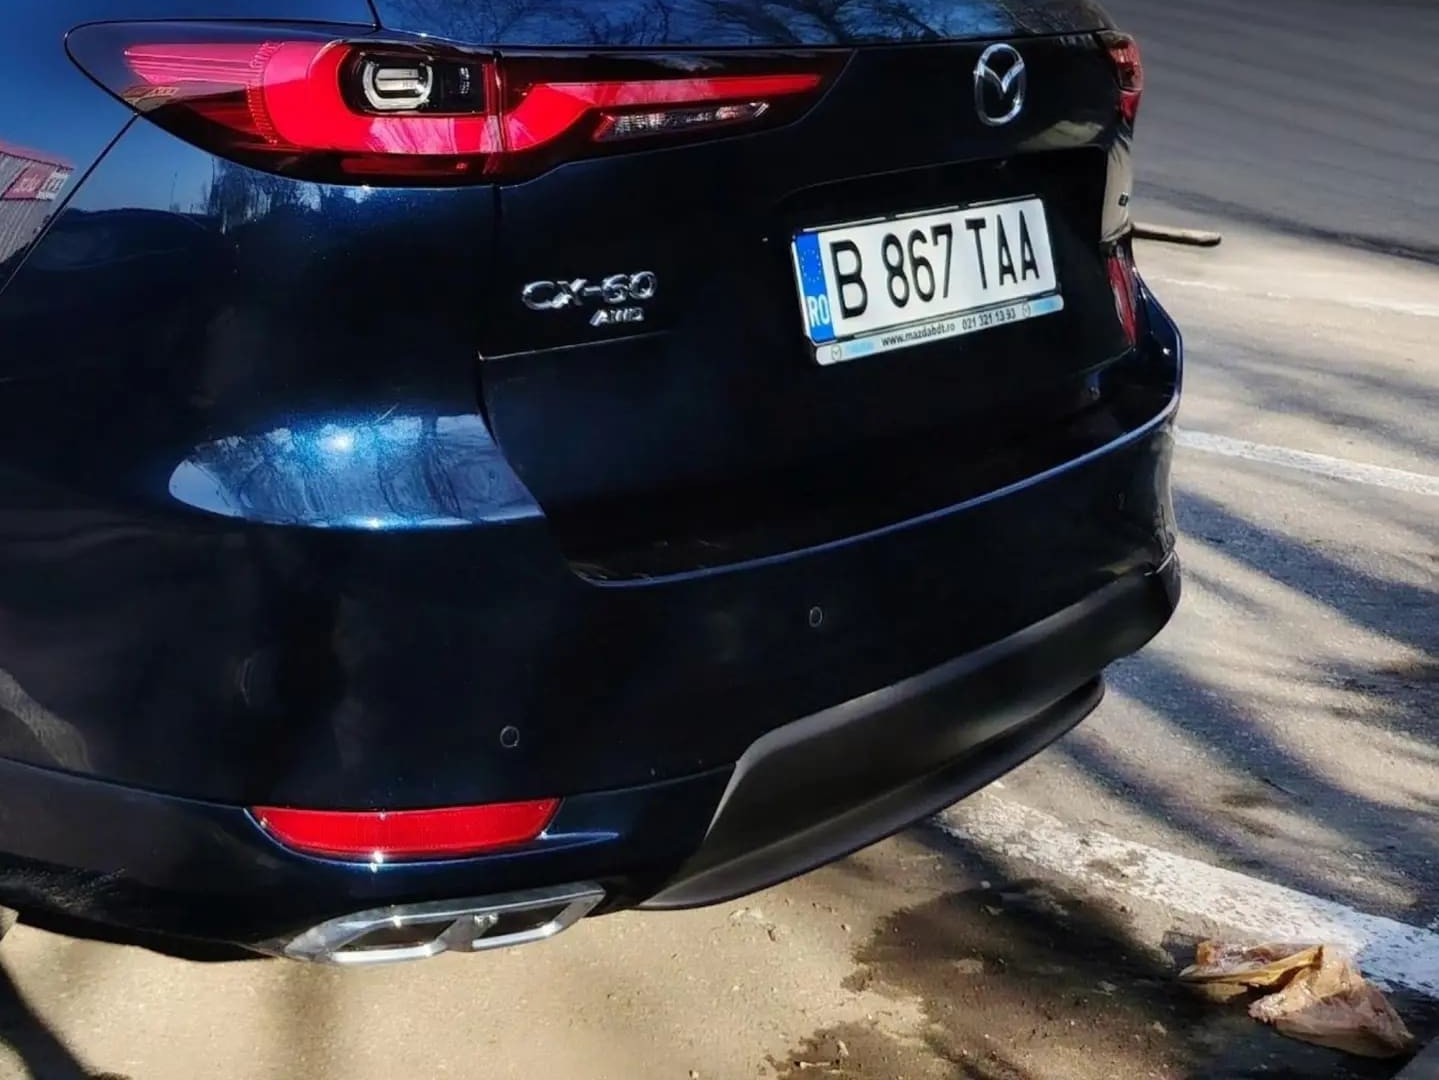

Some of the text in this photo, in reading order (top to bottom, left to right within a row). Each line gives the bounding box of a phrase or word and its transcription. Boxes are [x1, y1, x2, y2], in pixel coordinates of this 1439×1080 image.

[829, 210, 1040, 320] B 867 TAA
[521, 270, 657, 311] CX-60
[806, 294, 831, 328] RO
[962, 319, 977, 330] 021
[978, 314, 993, 326] 321
